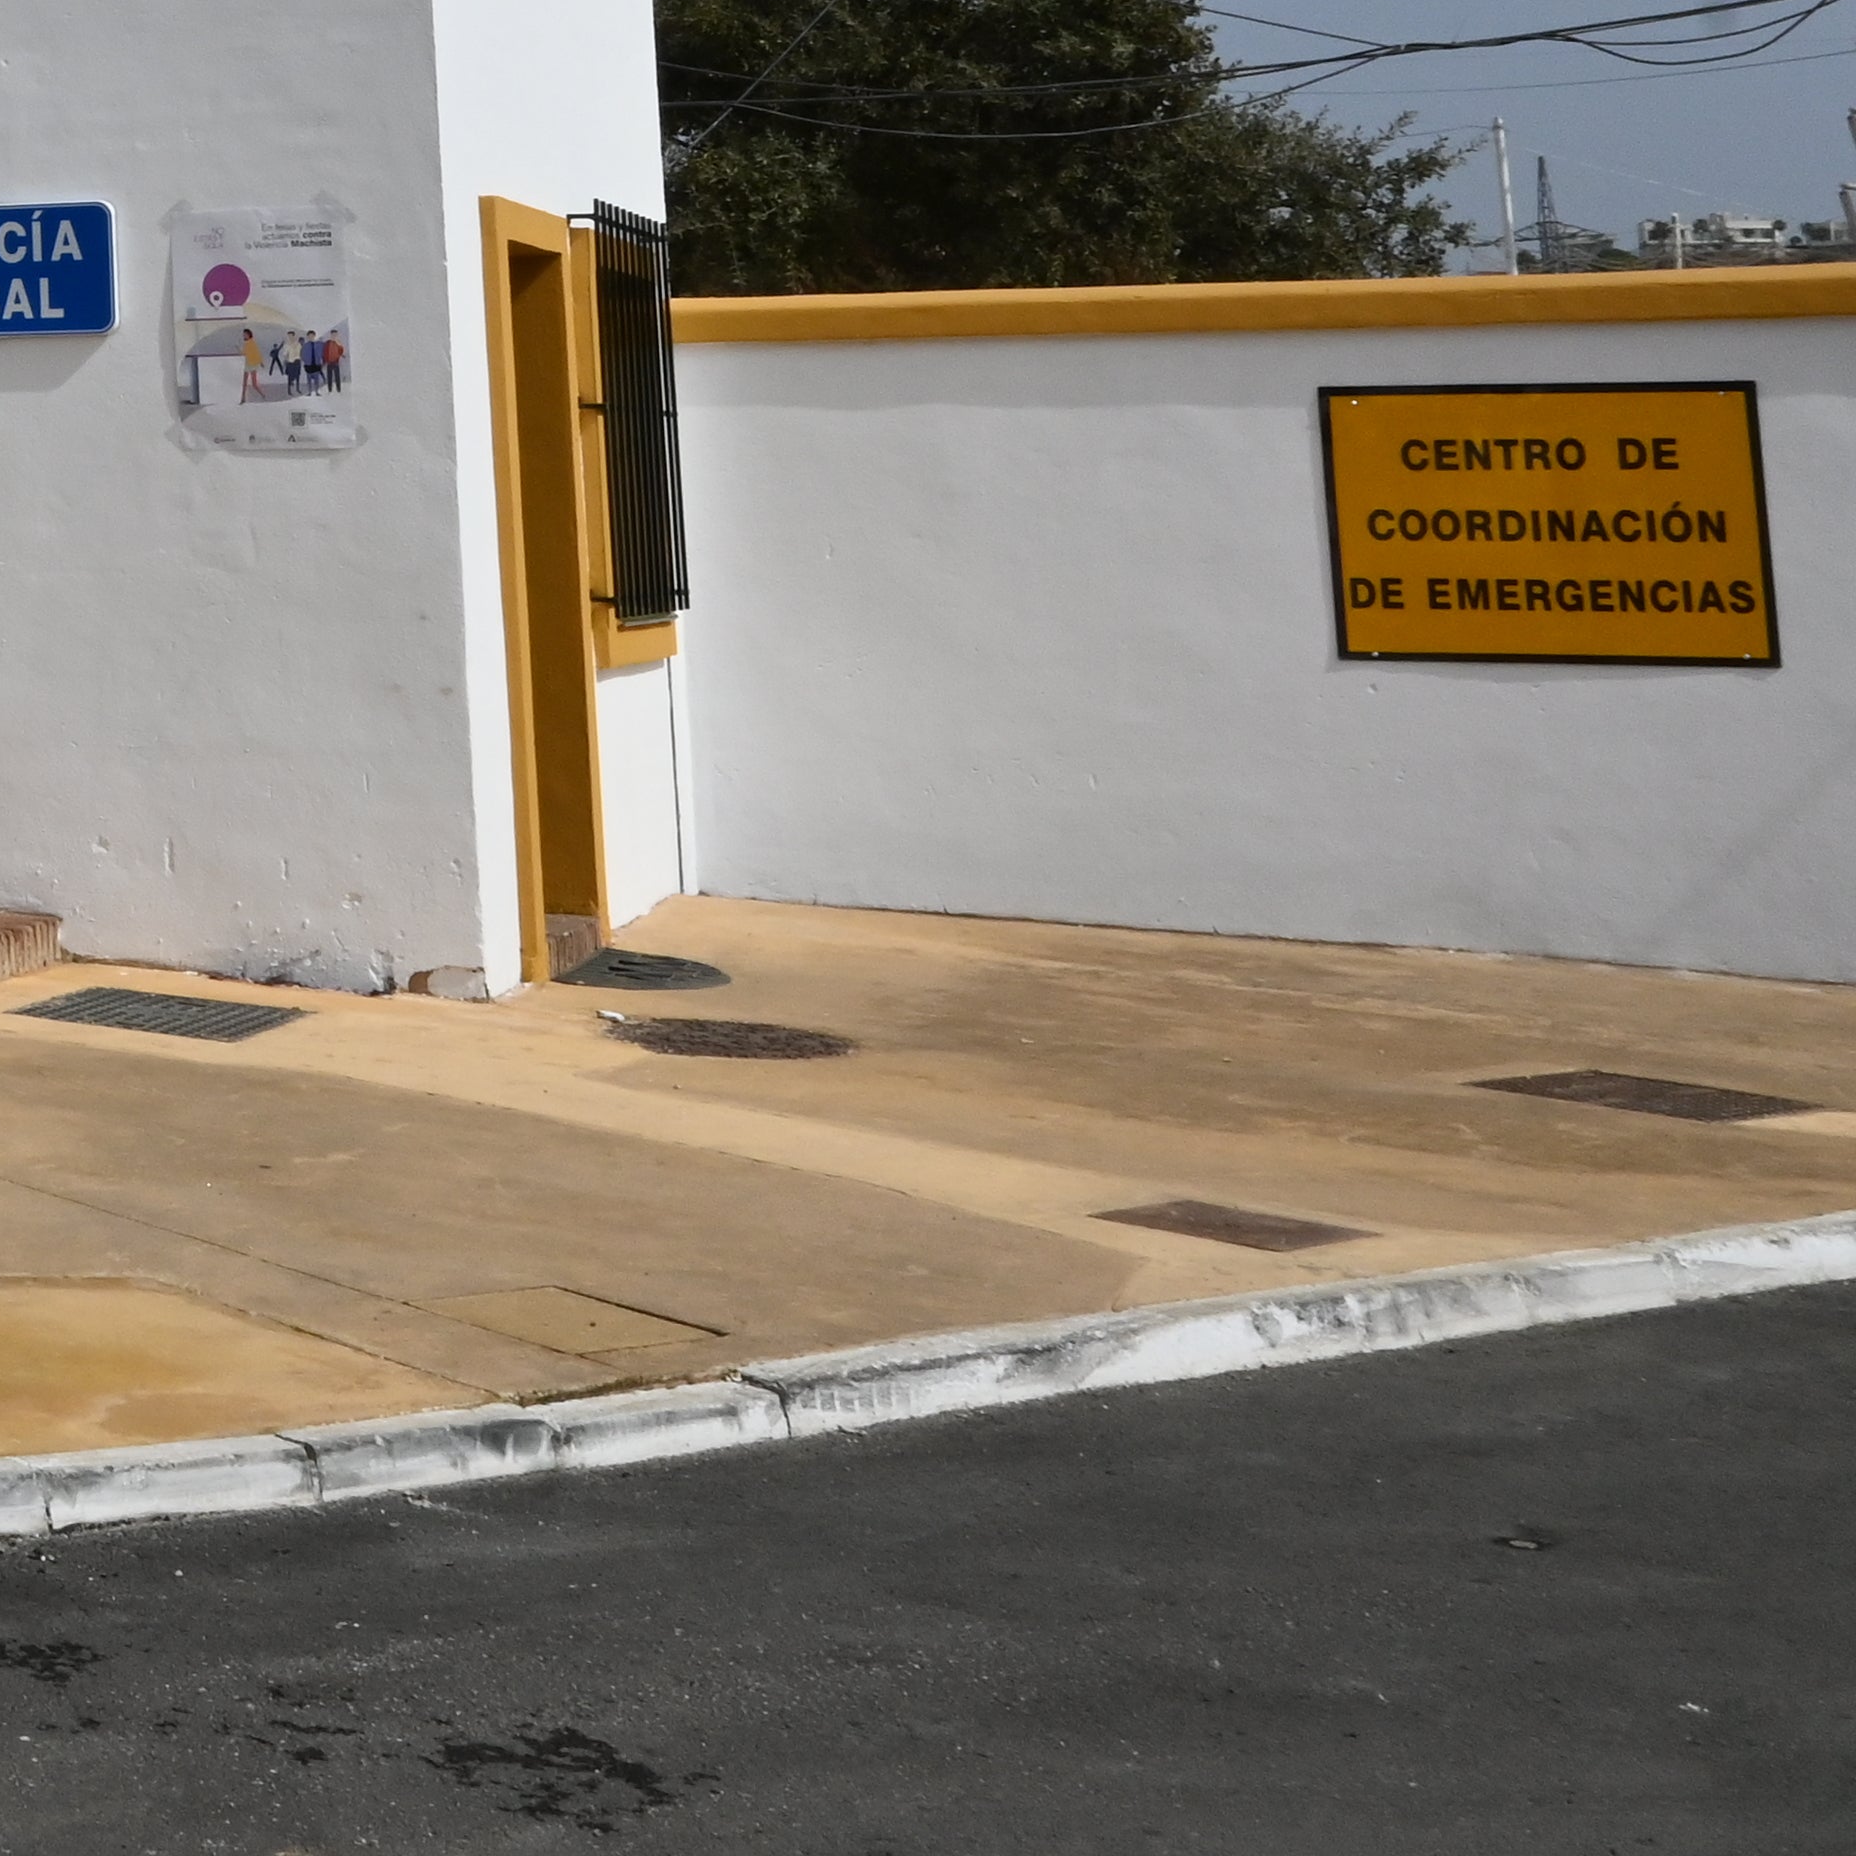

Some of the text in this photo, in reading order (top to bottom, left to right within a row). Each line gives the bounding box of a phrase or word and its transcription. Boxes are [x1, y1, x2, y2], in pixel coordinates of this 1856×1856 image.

[291, 239, 333, 248] Machista
[302, 230, 333, 239] contra
[1400, 437, 1680, 471] CENTRO DE
[1367, 502, 1729, 544] COORDINACIÓN
[1350, 577, 1757, 615] DE EMERGENCIAS
